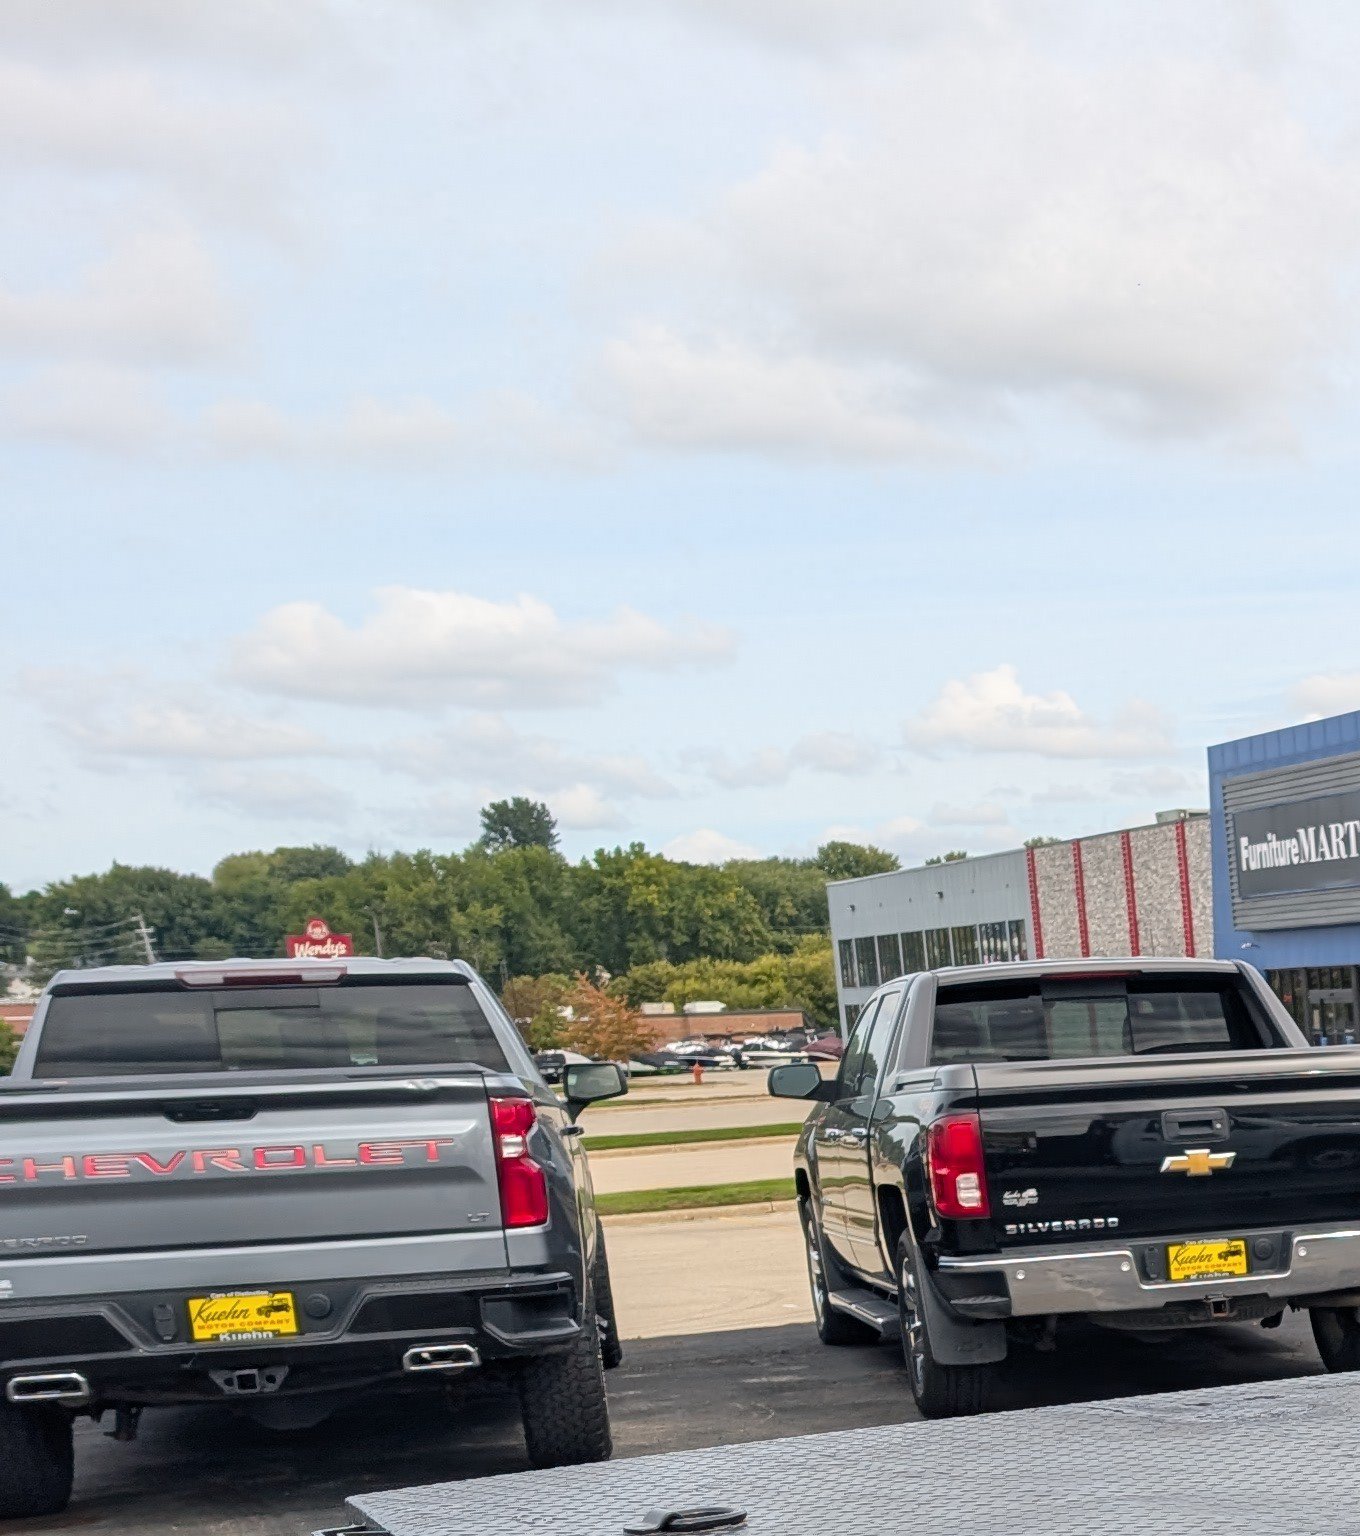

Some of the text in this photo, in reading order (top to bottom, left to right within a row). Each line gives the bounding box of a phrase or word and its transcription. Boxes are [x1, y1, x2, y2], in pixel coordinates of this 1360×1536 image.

[294, 938, 347, 959] Wendy's
[1005, 1217, 1119, 1235] SILVERADO
[1171, 1245, 1213, 1267] Kuehn
[193, 1298, 251, 1324] Kuehn
[197, 1318, 290, 1330] MOTOR COMPANY
